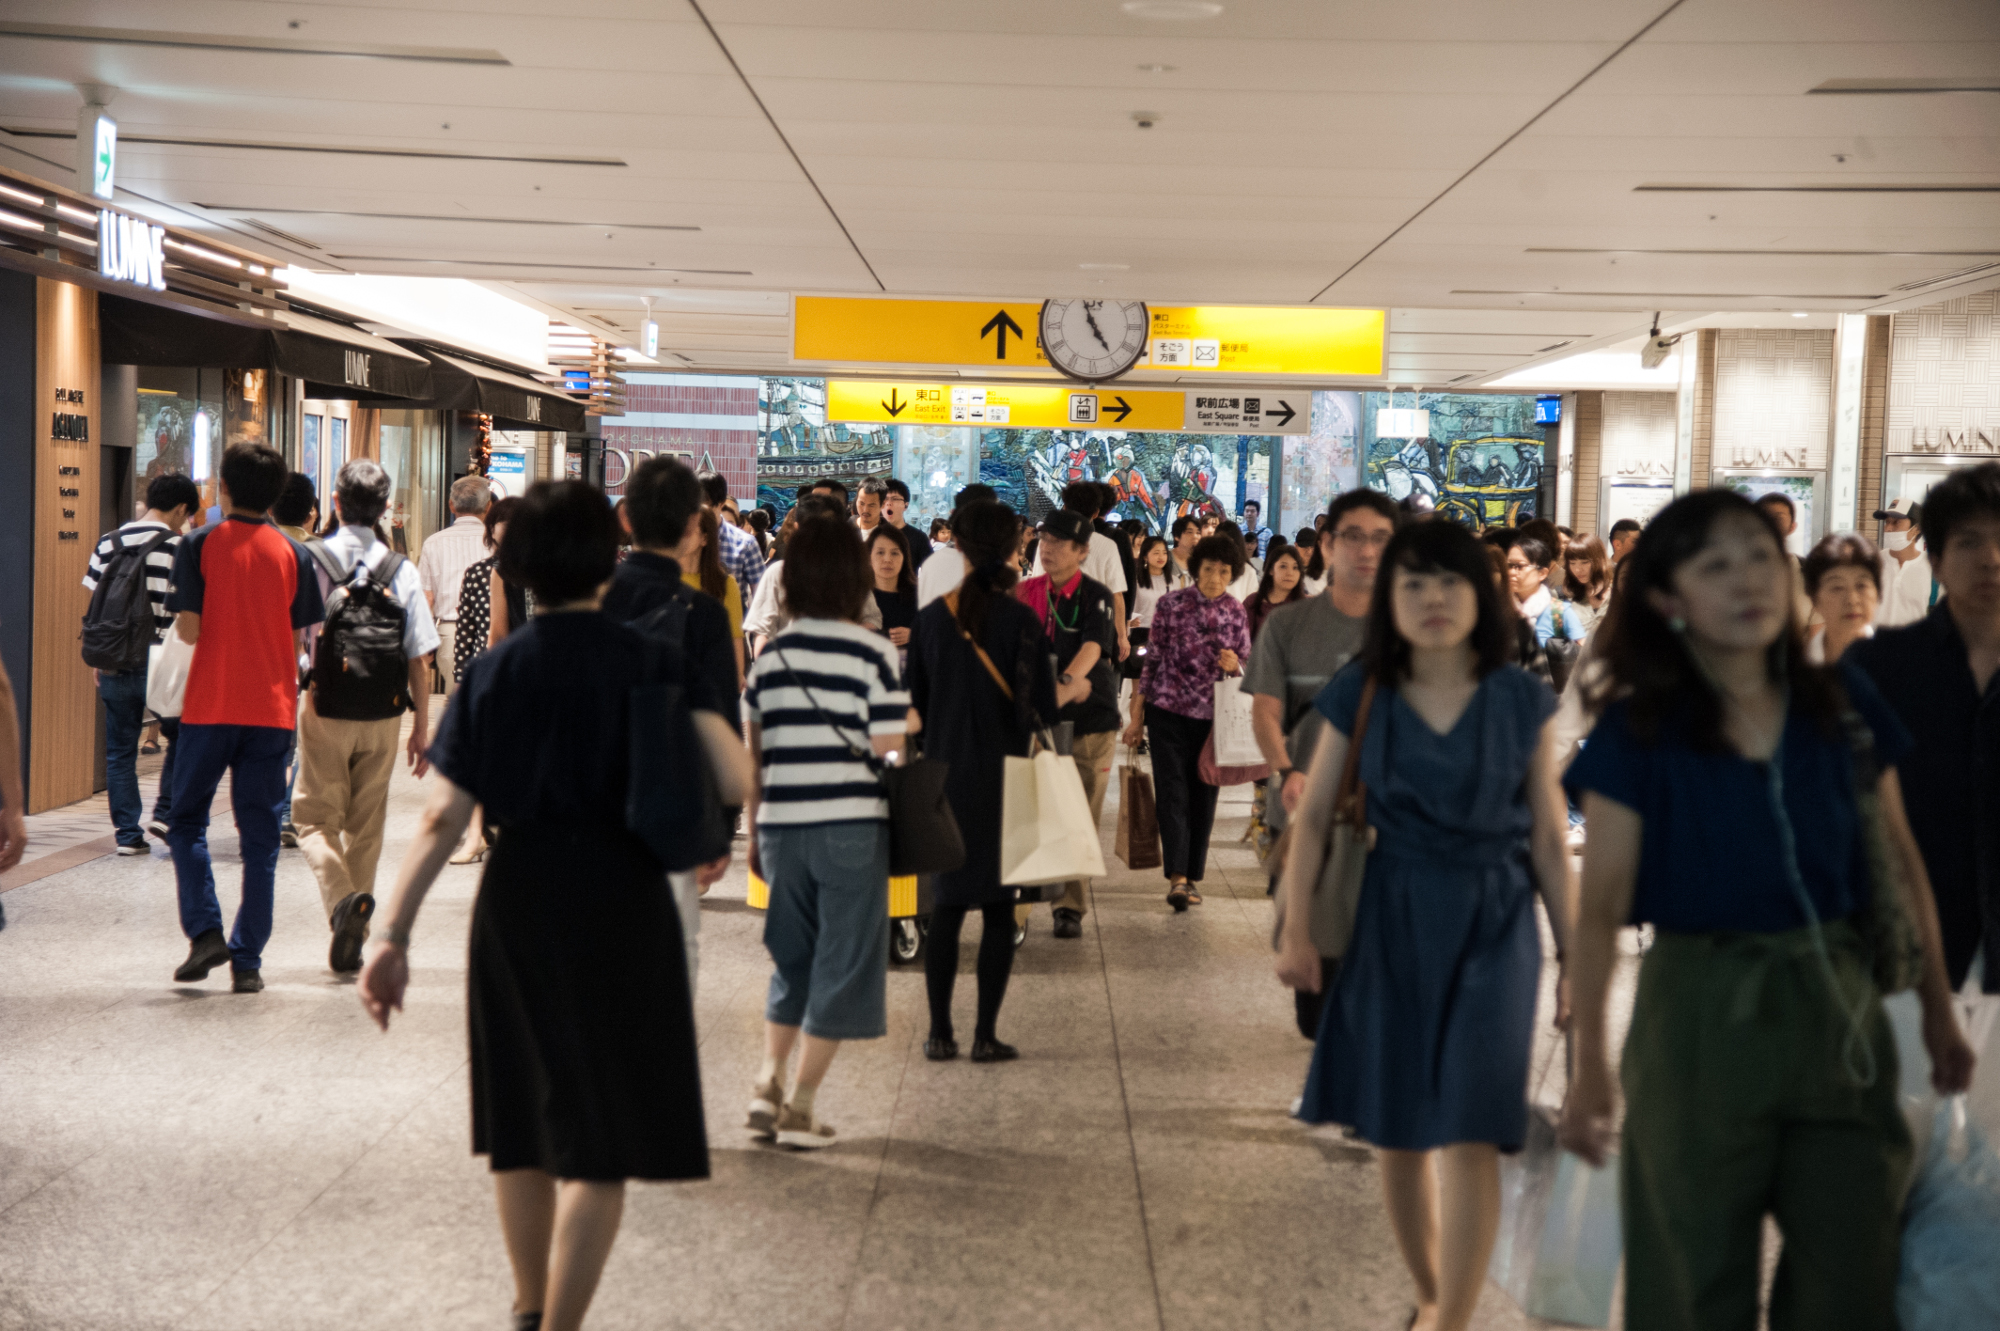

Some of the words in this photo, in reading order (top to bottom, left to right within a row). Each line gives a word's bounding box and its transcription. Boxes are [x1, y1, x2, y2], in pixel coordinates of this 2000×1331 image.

[1160, 343, 1184, 352] そごう
[1221, 343, 1249, 353] 郵便局
[1159, 352, 1178, 362] 方面
[1220, 355, 1236, 363] Post
[915, 389, 940, 401] 東口
[1196, 397, 1240, 409] 駅前広場
[915, 404, 930, 412] East
[932, 404, 946, 413] Exit
[1197, 411, 1213, 419] East
[1214, 412, 1240, 421] Square
[605, 433, 695, 446] OKOHAMA
[1912, 426, 2000, 453] LUMIN
